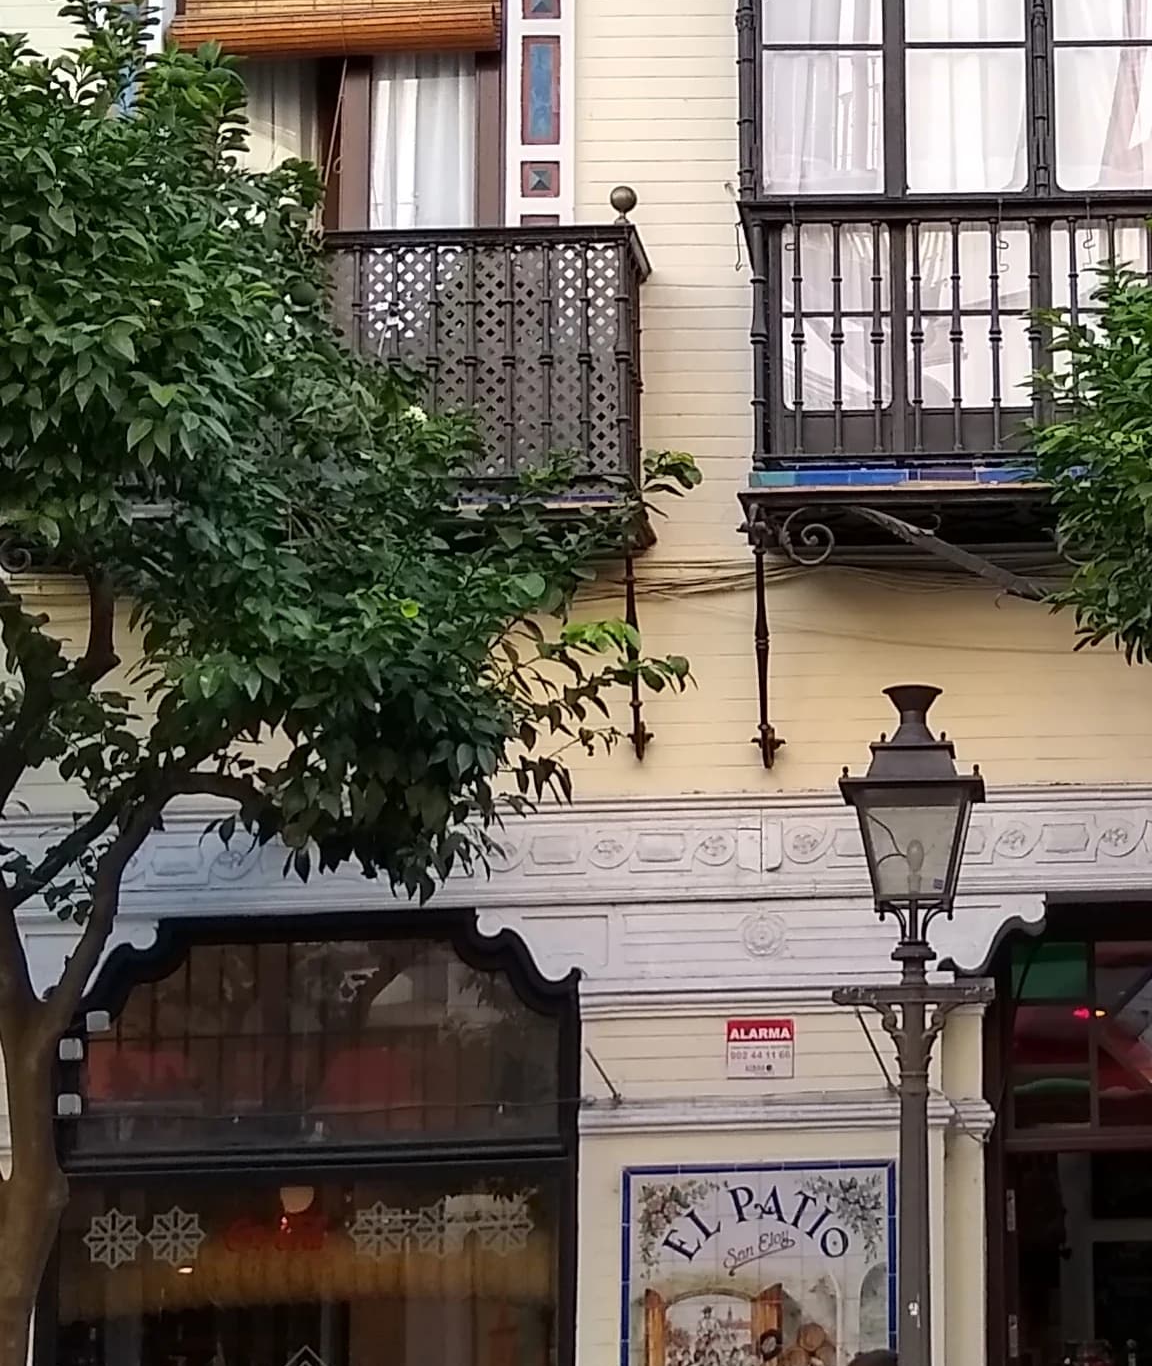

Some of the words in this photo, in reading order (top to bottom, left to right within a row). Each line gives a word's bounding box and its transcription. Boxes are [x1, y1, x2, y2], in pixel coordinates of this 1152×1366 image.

[729, 1027, 791, 1040] ALARMA
[662, 1207, 721, 1262] EL
[728, 1184, 849, 1260] PATIO
[723, 1247, 754, 1269] San
[758, 1230, 796, 1252] Eloy
